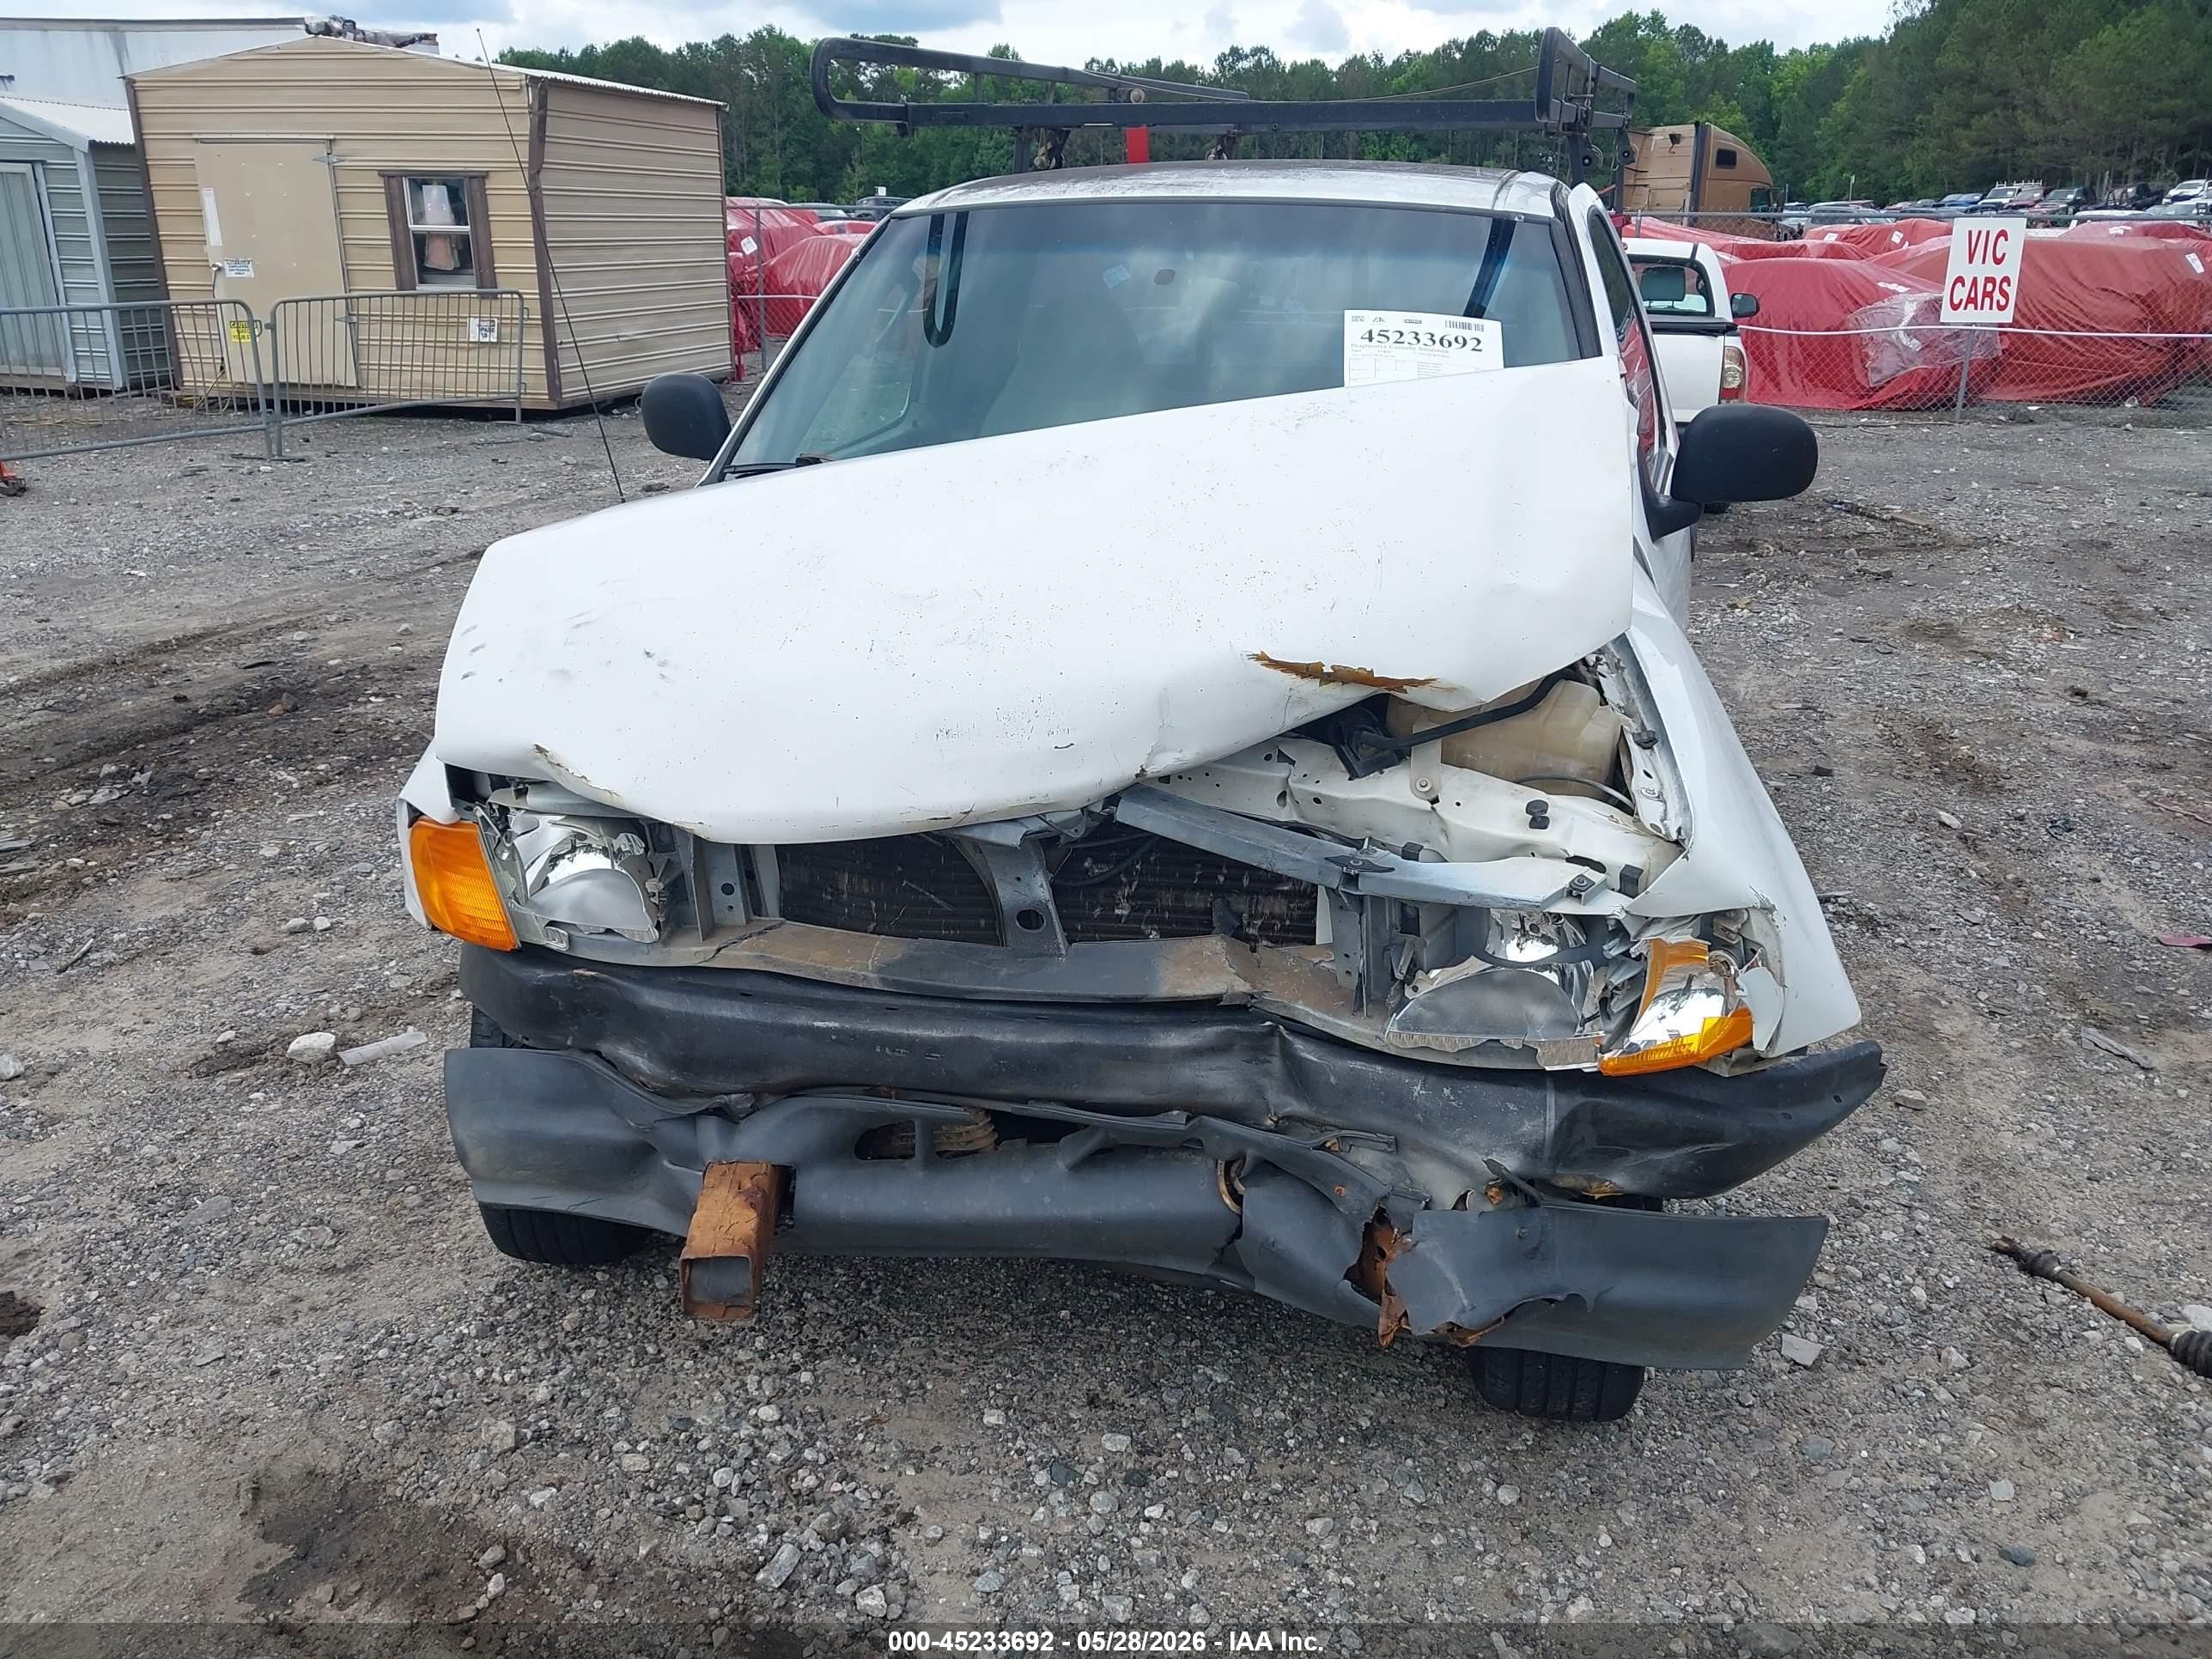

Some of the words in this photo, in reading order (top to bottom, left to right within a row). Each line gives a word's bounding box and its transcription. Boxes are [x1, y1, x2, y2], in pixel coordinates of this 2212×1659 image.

[1967, 228, 2009, 265] VIC
[1949, 275, 2011, 312] CARS
[1360, 329, 1483, 353] 45233692
